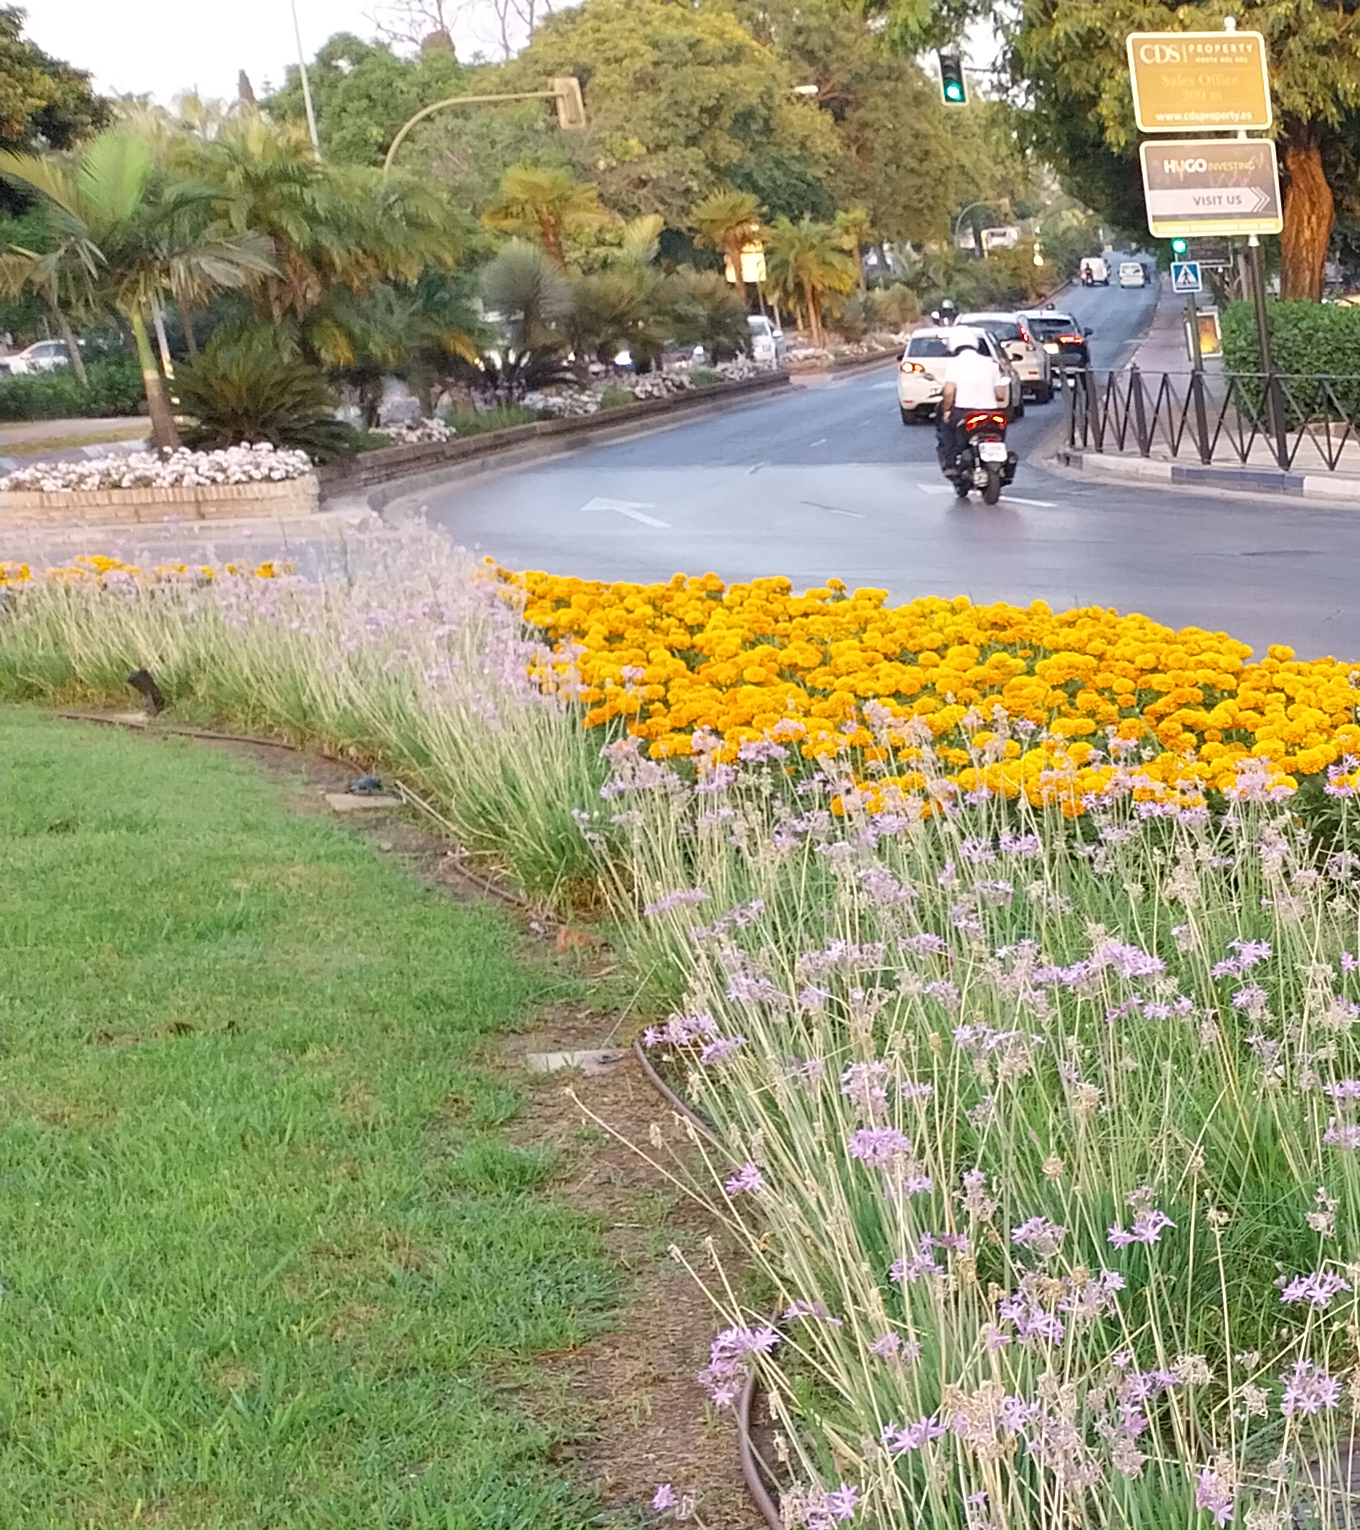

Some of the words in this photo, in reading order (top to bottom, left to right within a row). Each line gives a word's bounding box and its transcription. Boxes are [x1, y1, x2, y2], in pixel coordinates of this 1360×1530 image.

[1139, 43, 1181, 64] CDS
[1188, 43, 1253, 54] PROPERTY
[1160, 73, 1195, 87] Sales
[1197, 72, 1238, 86] Office
[1210, 91, 1222, 101] m
[1154, 110, 1253, 122] www.cdsproperty.es
[1163, 158, 1207, 173] HUGO
[1192, 196, 1223, 206] VISIT
[1226, 195, 1242, 206] US
